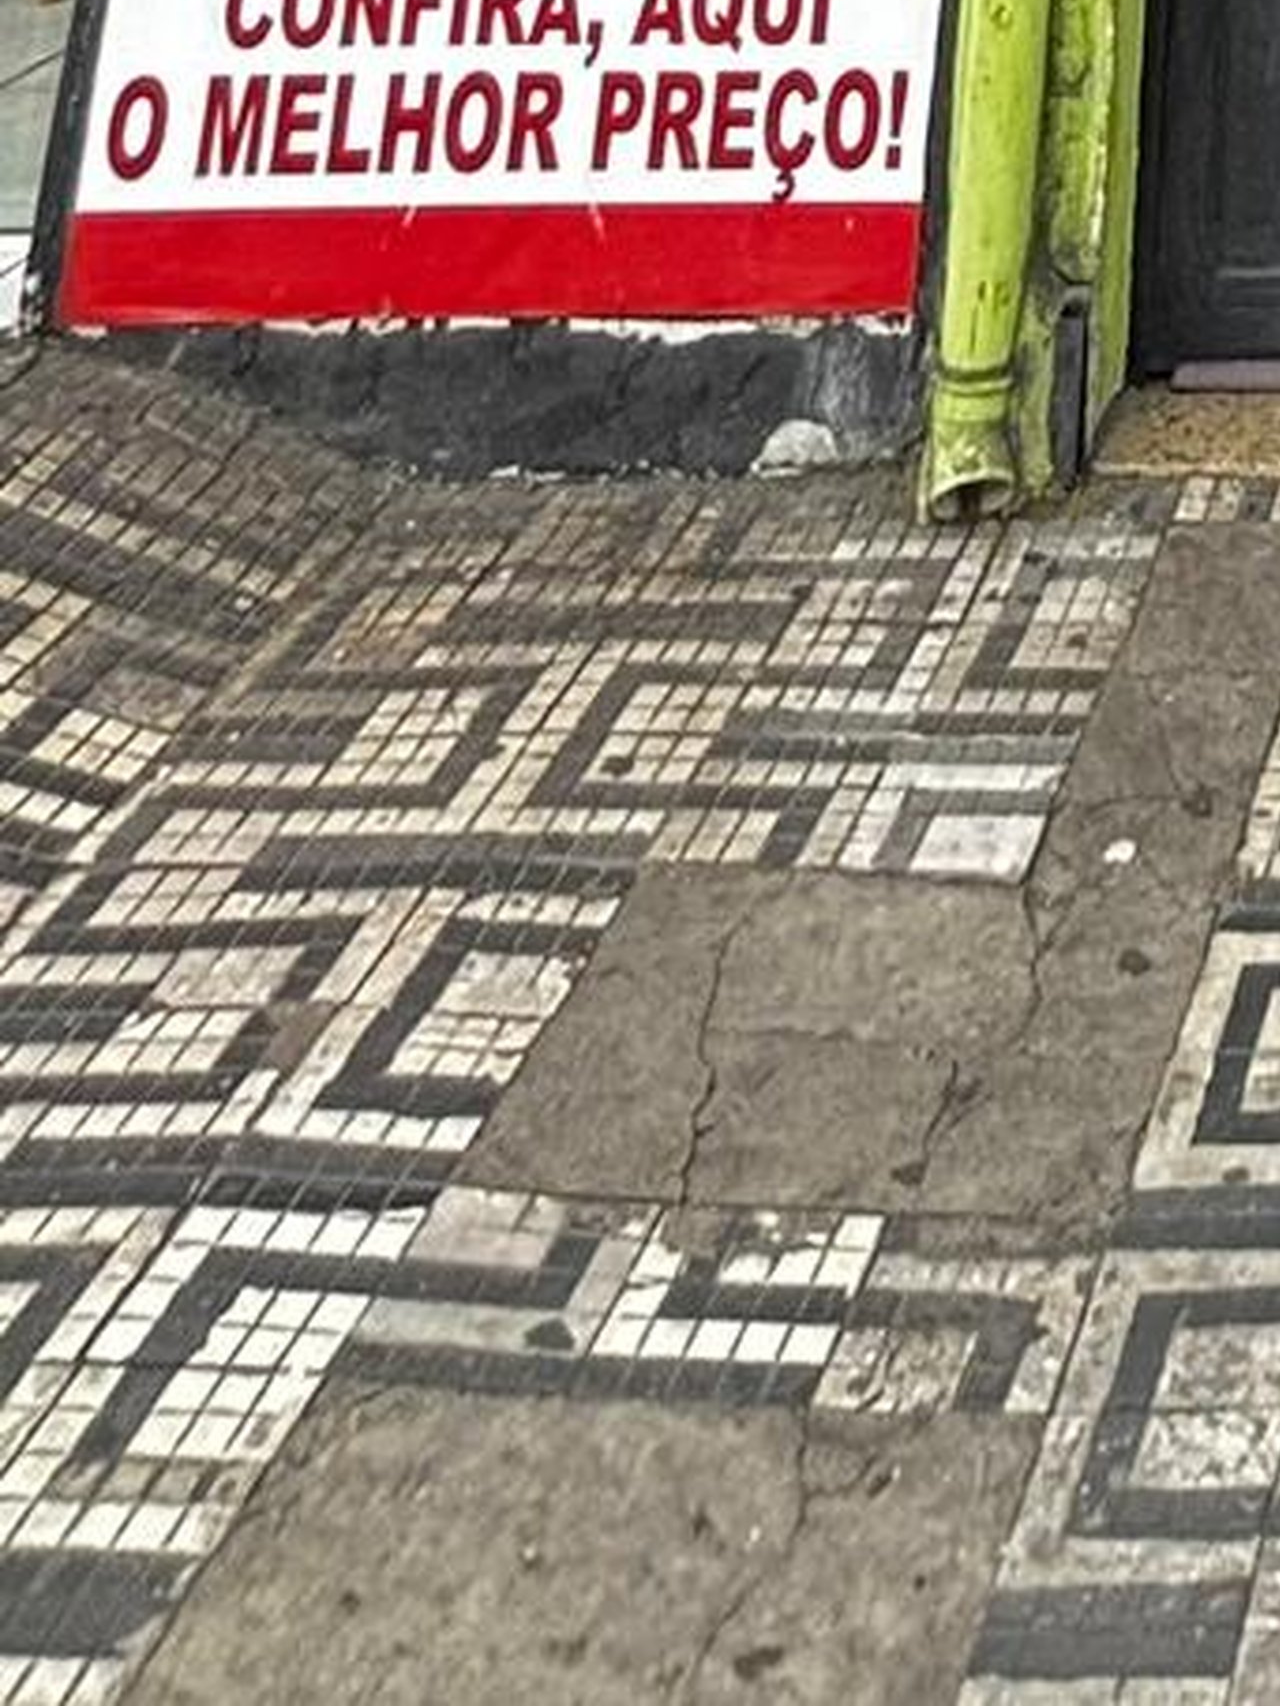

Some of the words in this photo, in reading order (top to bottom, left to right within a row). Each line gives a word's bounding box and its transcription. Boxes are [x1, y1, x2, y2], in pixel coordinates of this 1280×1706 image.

[106, 74, 170, 181] O
[193, 72, 565, 177] MELHOR
[590, 67, 912, 202] PREÇO!
